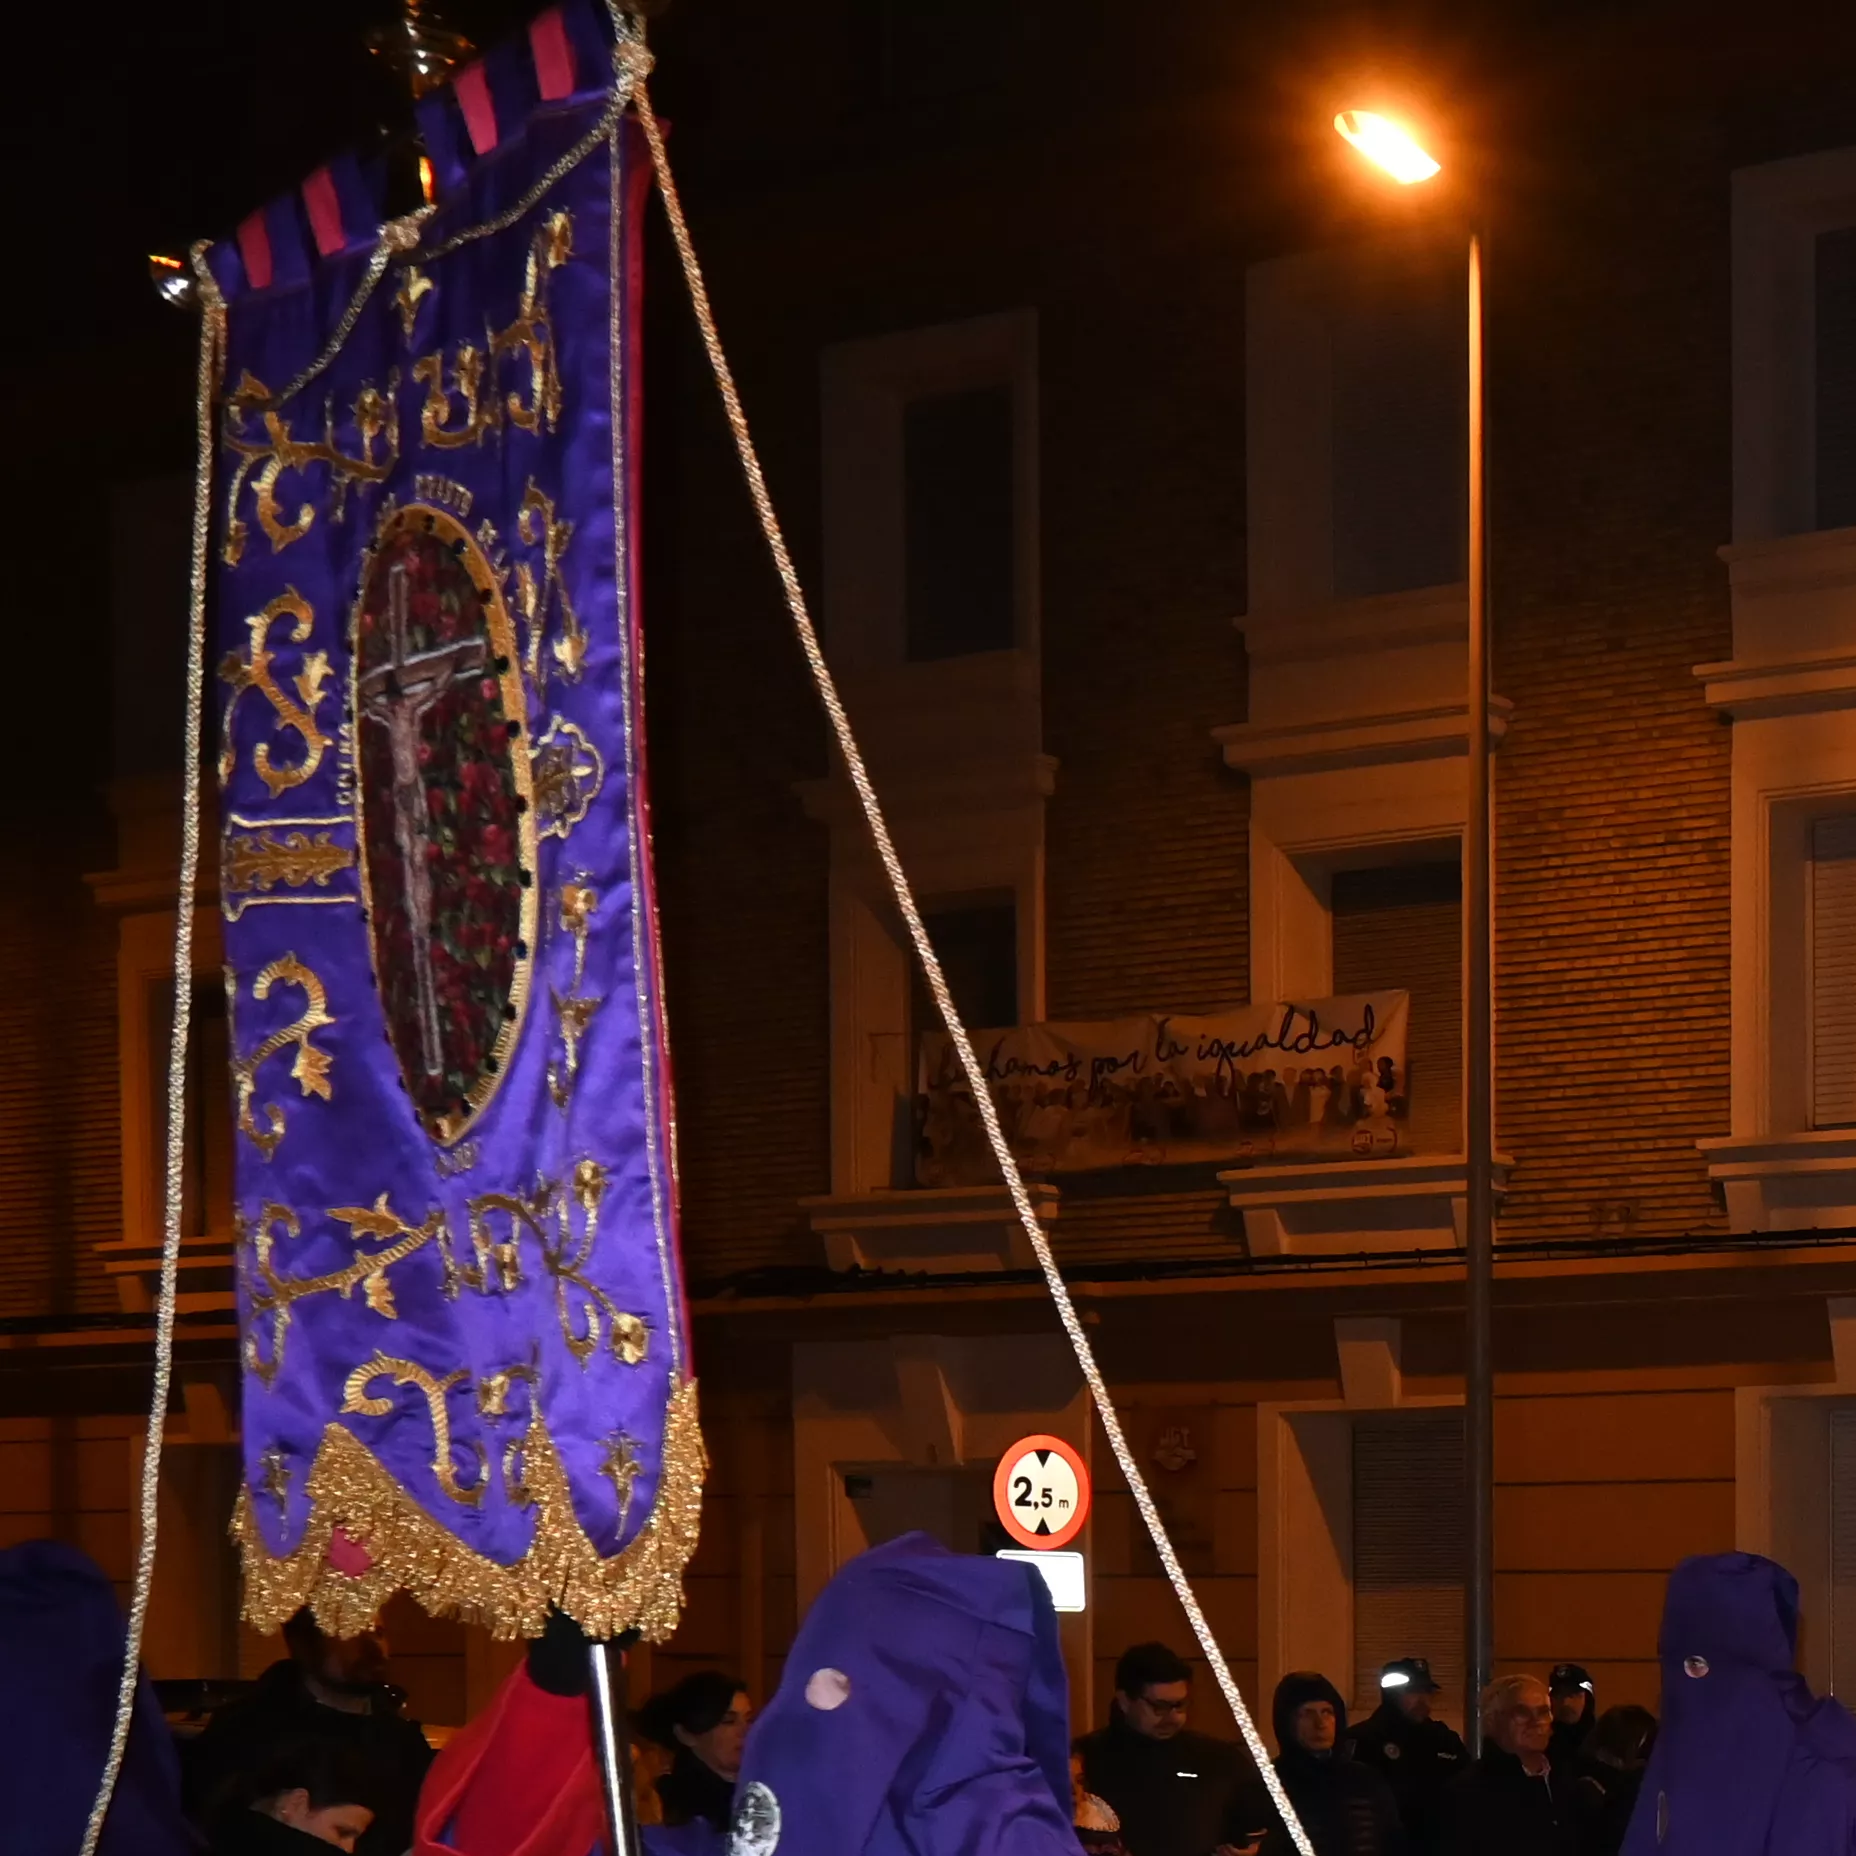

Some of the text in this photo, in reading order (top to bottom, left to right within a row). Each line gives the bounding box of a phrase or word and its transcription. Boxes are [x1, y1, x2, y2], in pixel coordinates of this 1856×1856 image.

[927, 1003, 1377, 1103] Luhamos por la igualdad
[1013, 1476, 1070, 1511] 2,5 m
